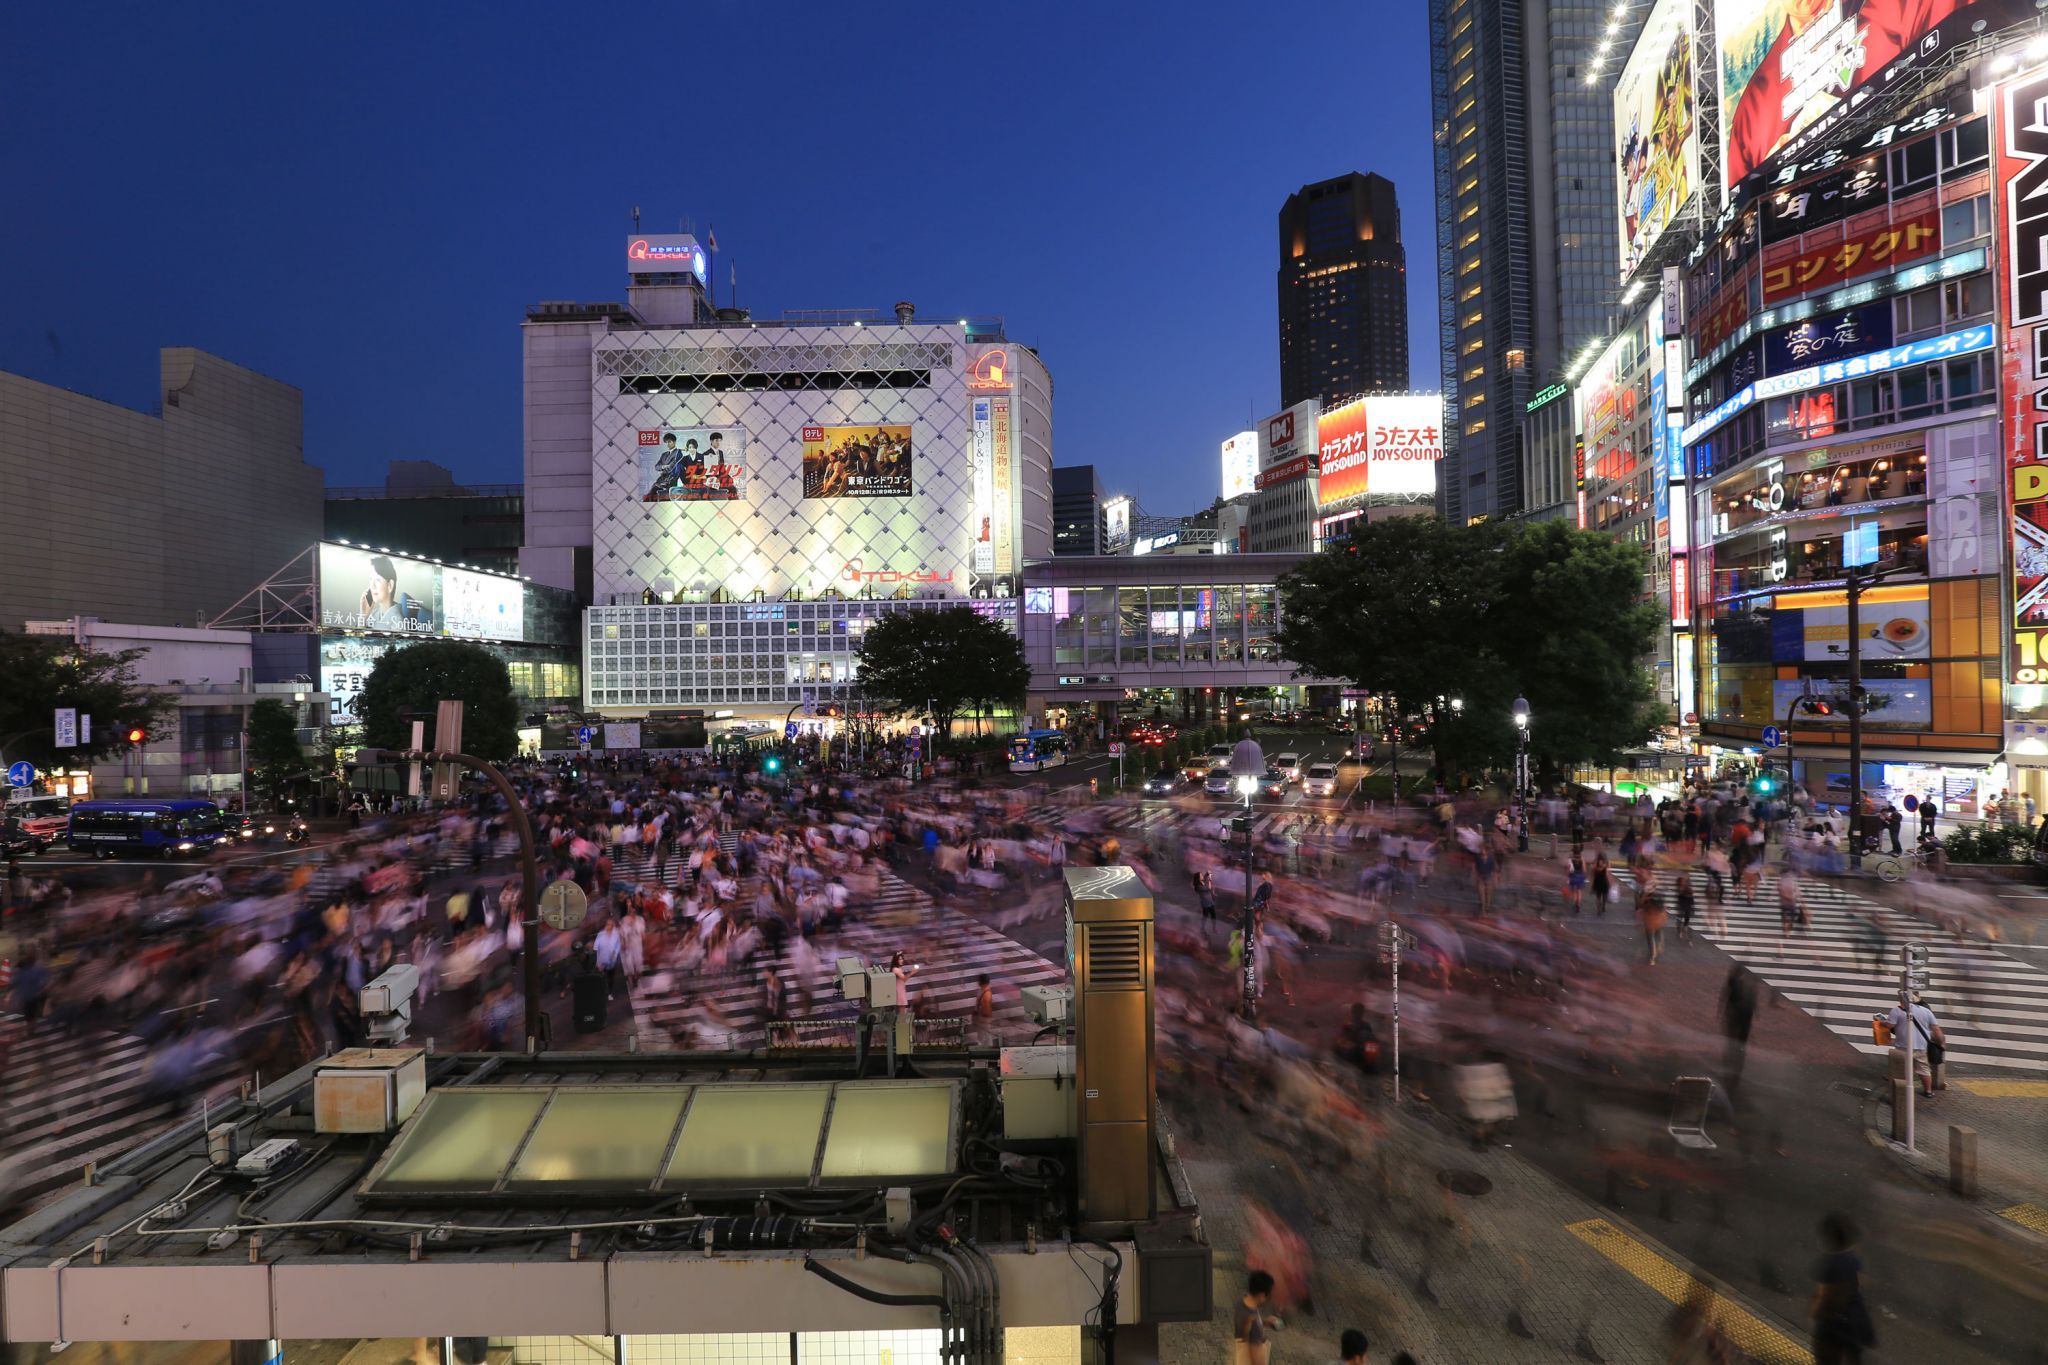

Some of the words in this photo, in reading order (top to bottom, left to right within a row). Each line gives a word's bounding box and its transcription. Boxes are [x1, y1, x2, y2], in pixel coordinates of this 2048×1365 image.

[1765, 223, 1936, 293] コンタクト
[1667, 279, 1677, 325] 大外ビル
[1761, 376, 1813, 394] AEON
[1823, 330, 1986, 382] 英会話イーオン
[1527, 392, 1547, 410] MARK
[1548, 384, 1567, 401] CITY
[641, 433, 658, 441] 日テレ
[1321, 431, 1365, 462] カラオケ
[1375, 426, 1439, 447] うたスキ
[1870, 438, 1913, 454] Dining
[1321, 451, 1367, 476] JOYSOUND
[1372, 448, 1443, 461] JOYSOUND
[685, 463, 743, 478] ダンダリン
[848, 475, 910, 486] 東京バンドワゴン
[861, 570, 955, 583] TOKYU
[321, 608, 375, 628] 吉永小百合
[391, 614, 434, 633] SoftBank
